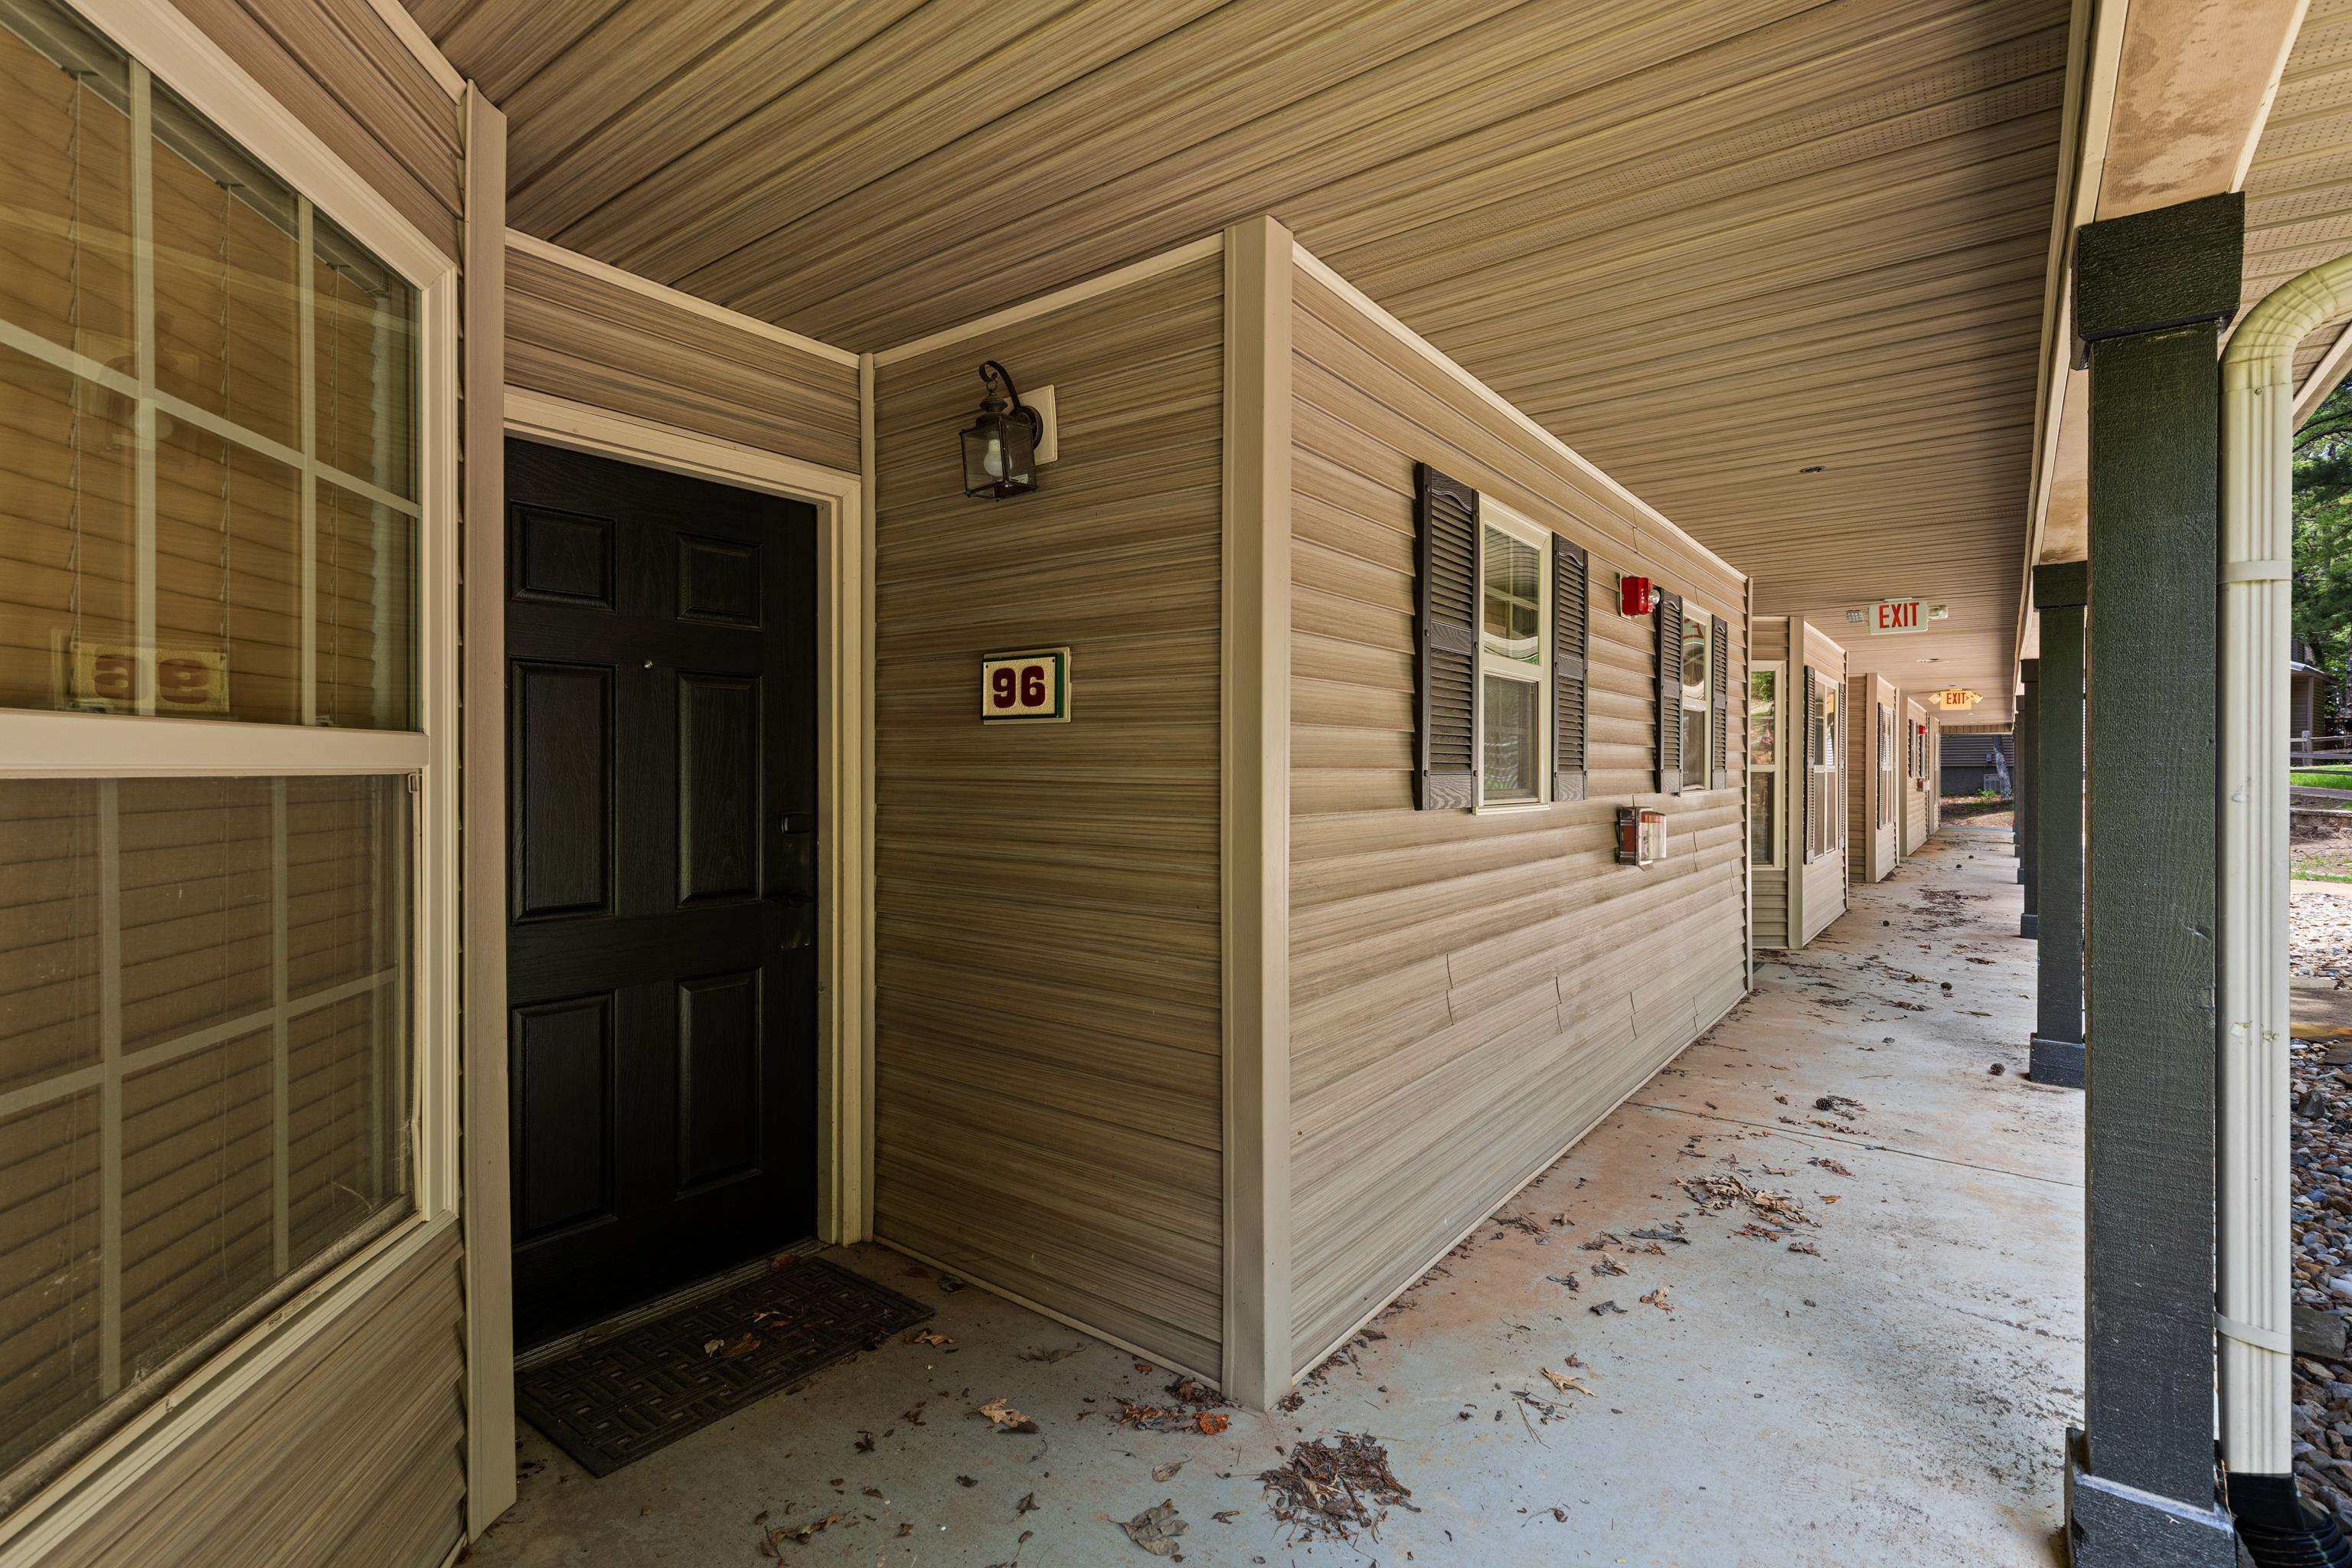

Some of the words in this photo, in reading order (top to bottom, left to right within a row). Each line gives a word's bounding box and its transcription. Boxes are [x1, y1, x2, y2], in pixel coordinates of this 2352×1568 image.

[1879, 602, 1919, 629] EXIT
[992, 665, 1046, 709] 96
[1946, 692, 1966, 704] EXIT
